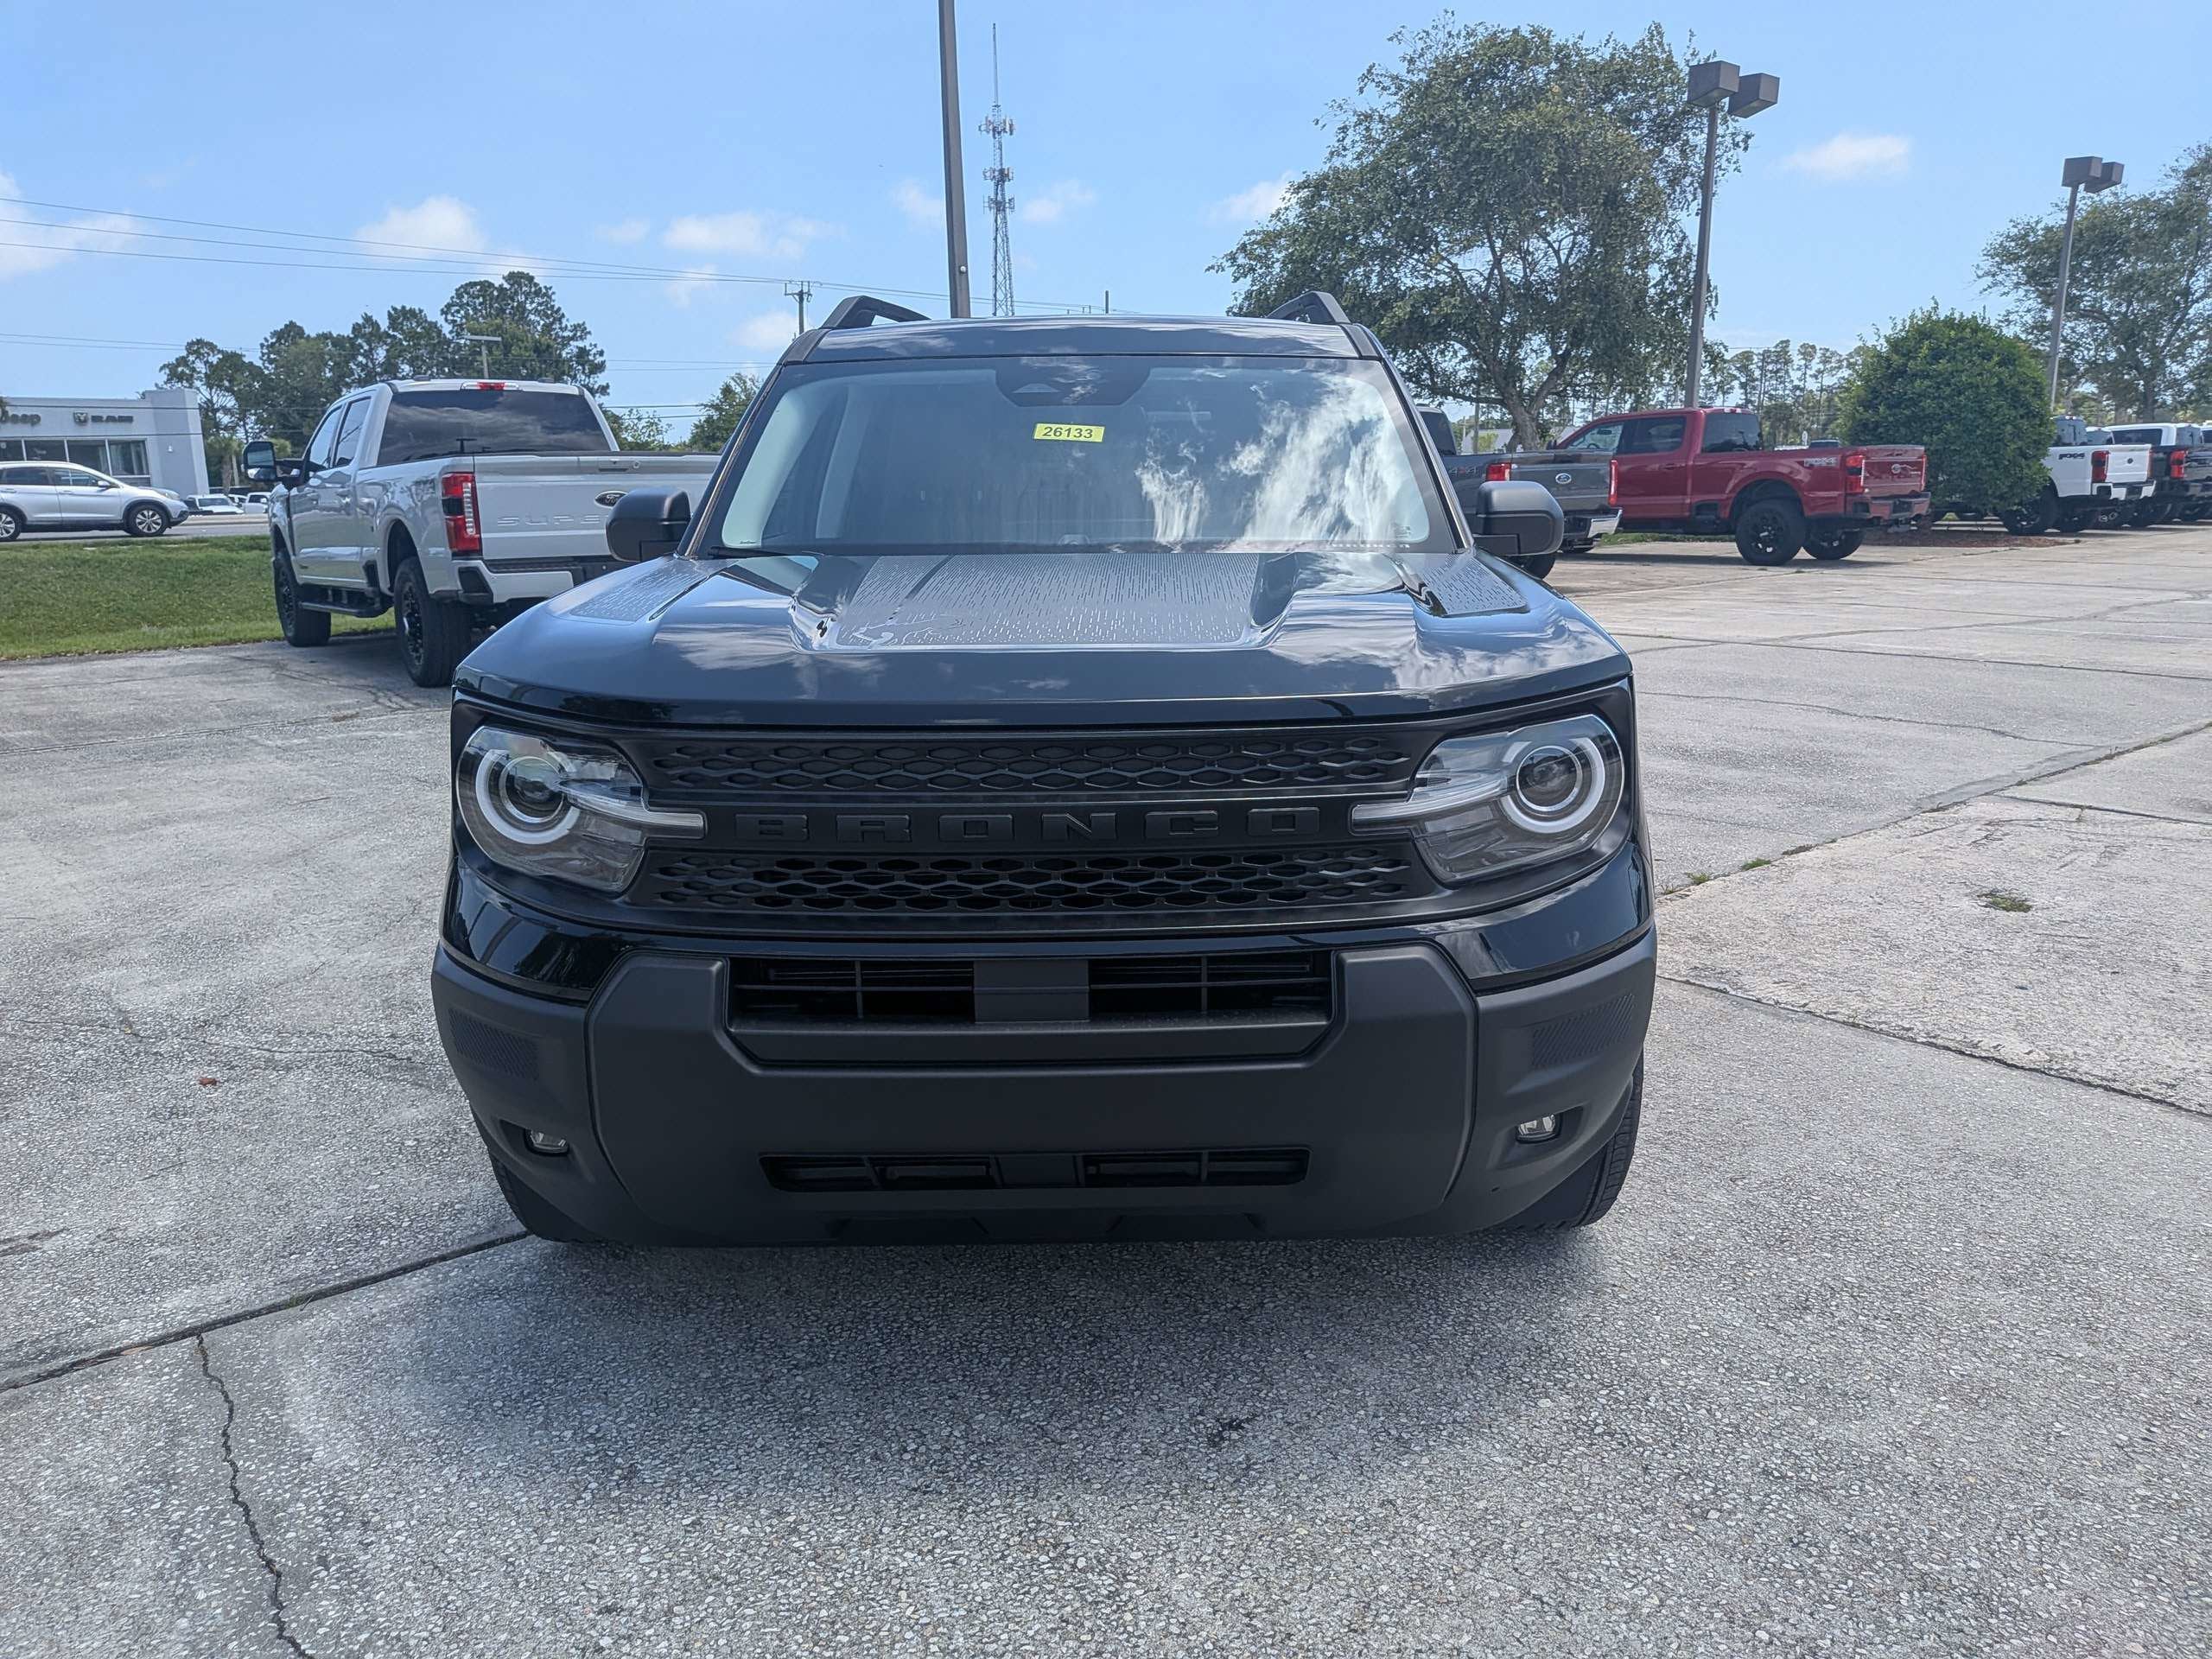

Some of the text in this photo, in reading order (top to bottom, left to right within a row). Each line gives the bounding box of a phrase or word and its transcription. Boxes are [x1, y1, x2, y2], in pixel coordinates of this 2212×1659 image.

[1042, 426, 1093, 438] 26133
[497, 514, 609, 526] SUPE
[734, 807, 1320, 843] BRONCO
